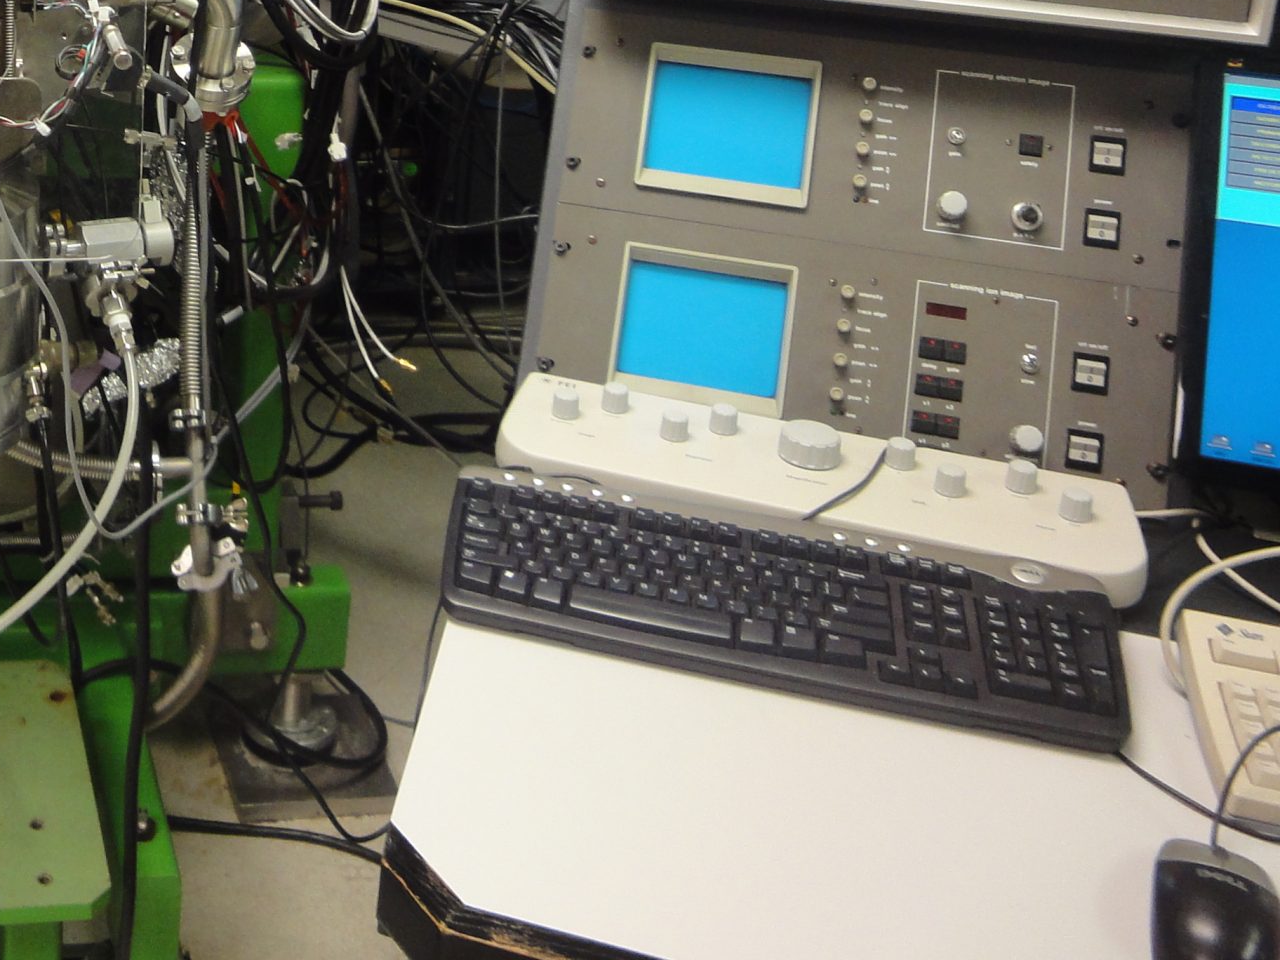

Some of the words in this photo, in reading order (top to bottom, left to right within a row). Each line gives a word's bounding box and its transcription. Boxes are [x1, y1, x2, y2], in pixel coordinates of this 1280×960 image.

[961, 71, 994, 80] scanning
[995, 74, 1026, 83] electron
[1027, 78, 1051, 87] image
[880, 85, 904, 93] intensity
[858, 292, 884, 300] intensity
[950, 283, 984, 295] scanning
[985, 287, 999, 295] ion
[999, 289, 1025, 300] image
